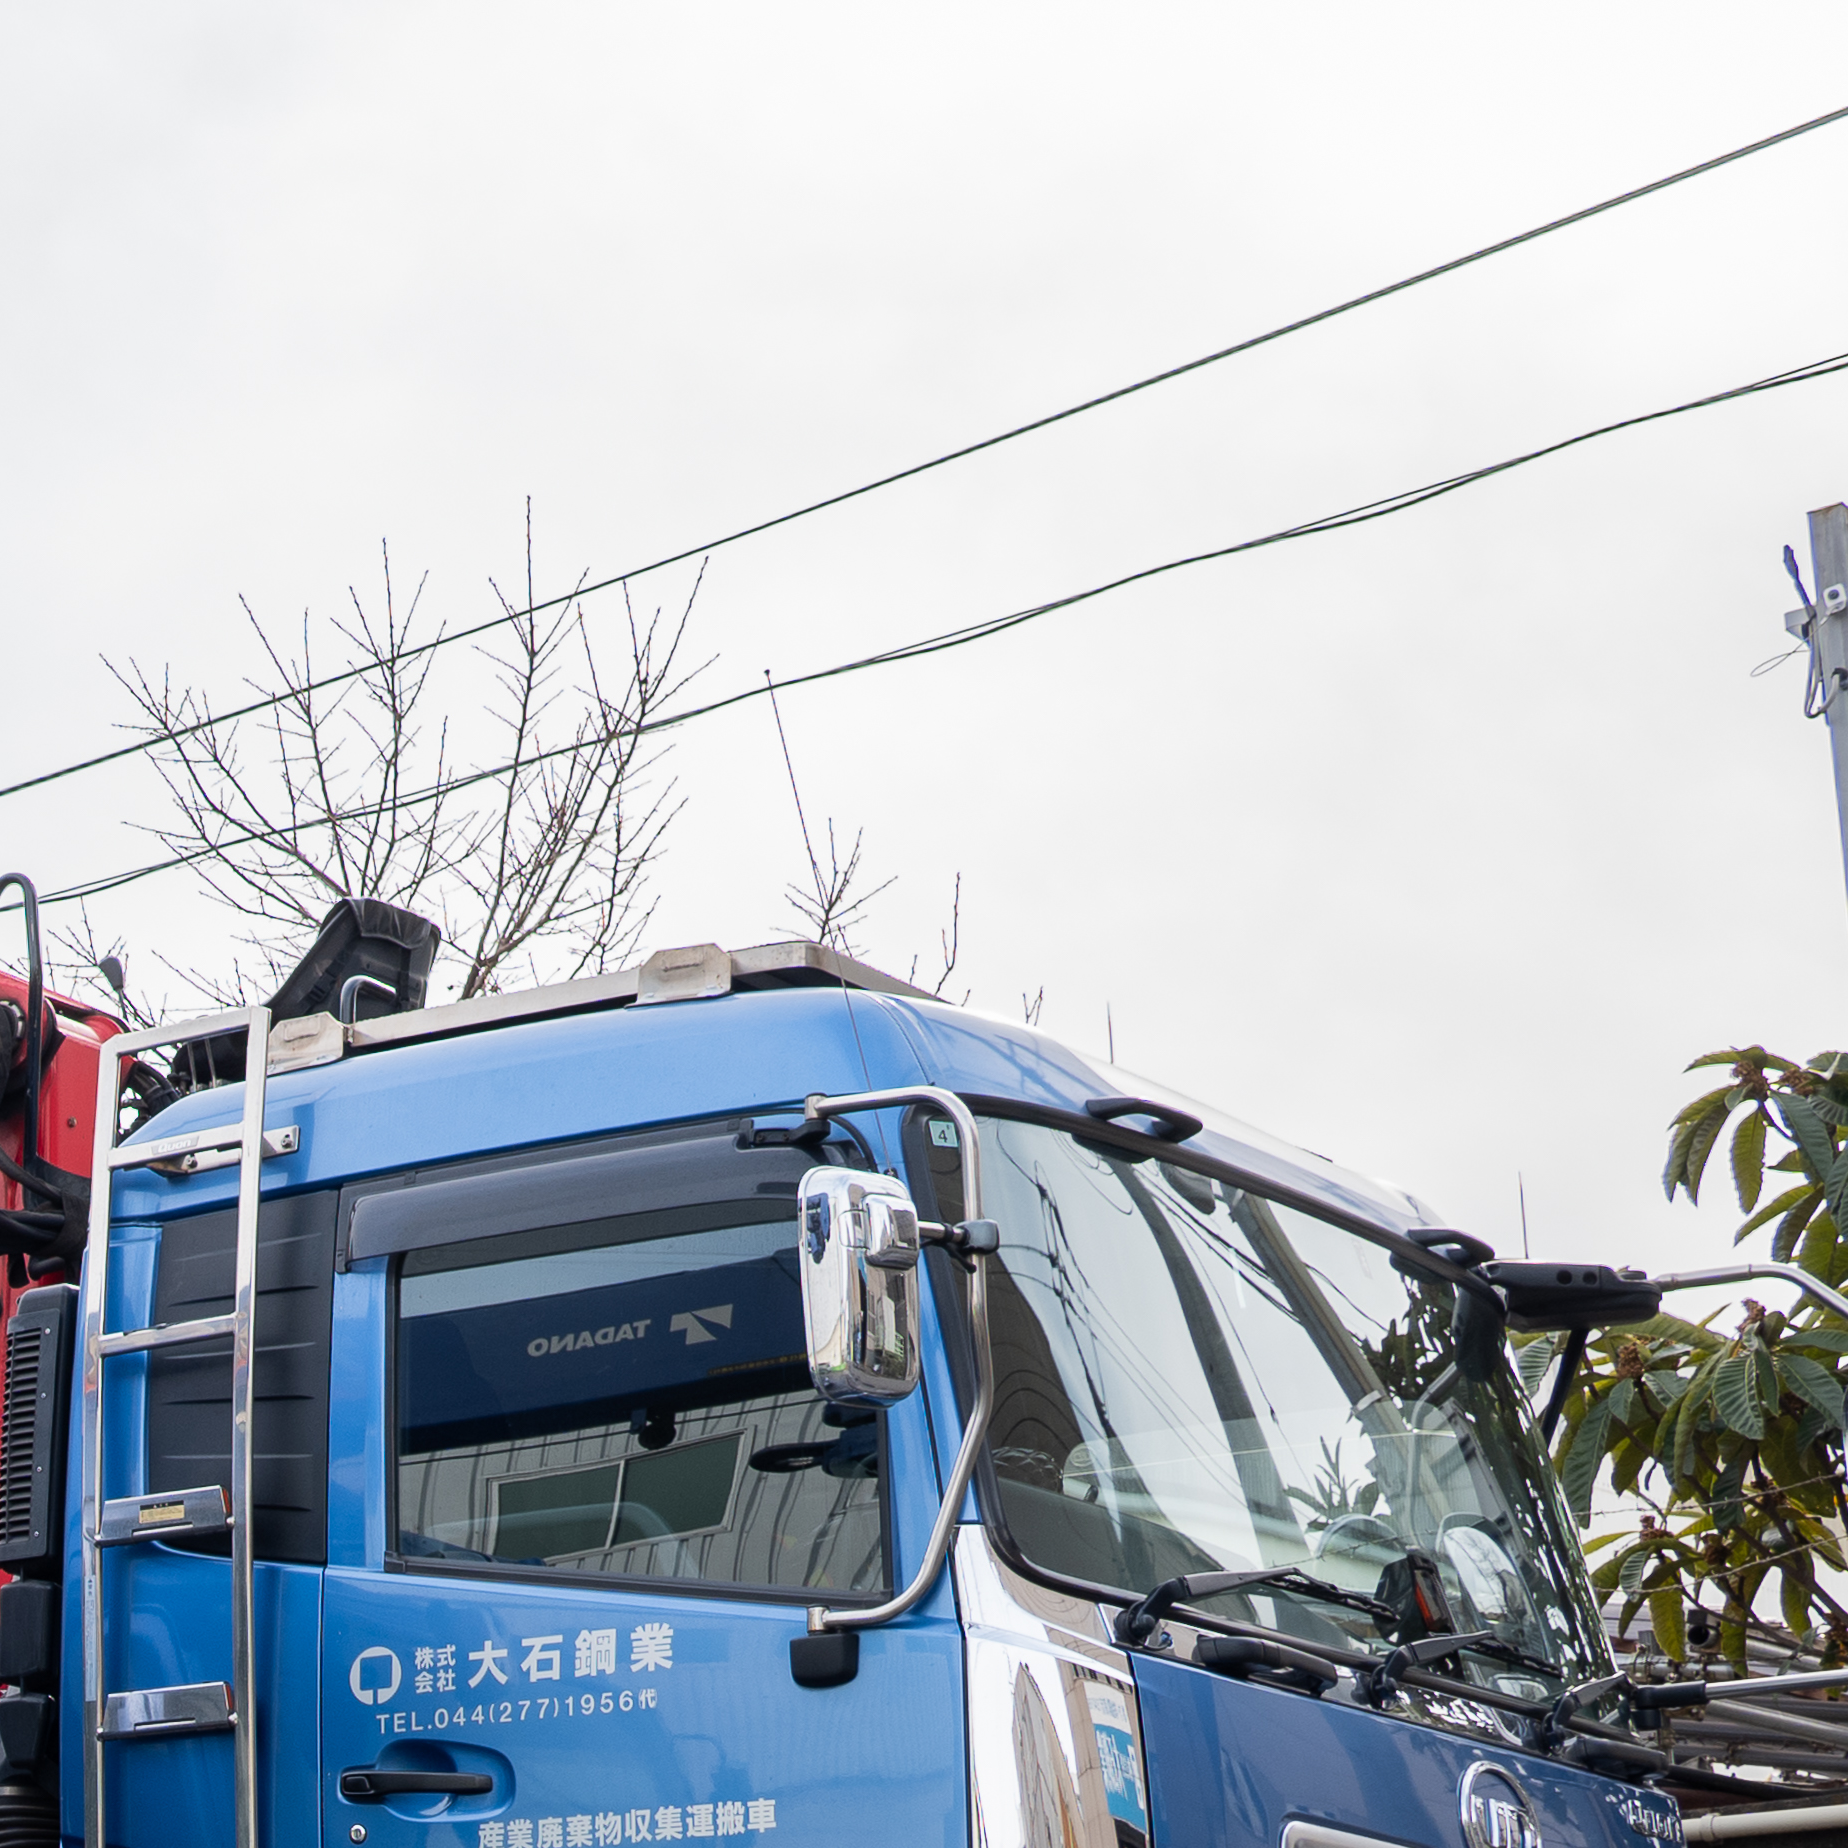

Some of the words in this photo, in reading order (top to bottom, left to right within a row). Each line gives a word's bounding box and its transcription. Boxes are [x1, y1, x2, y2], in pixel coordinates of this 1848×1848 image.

[157, 1137, 193, 1153] Quon
[467, 1623, 674, 1689] 大石鋼業
